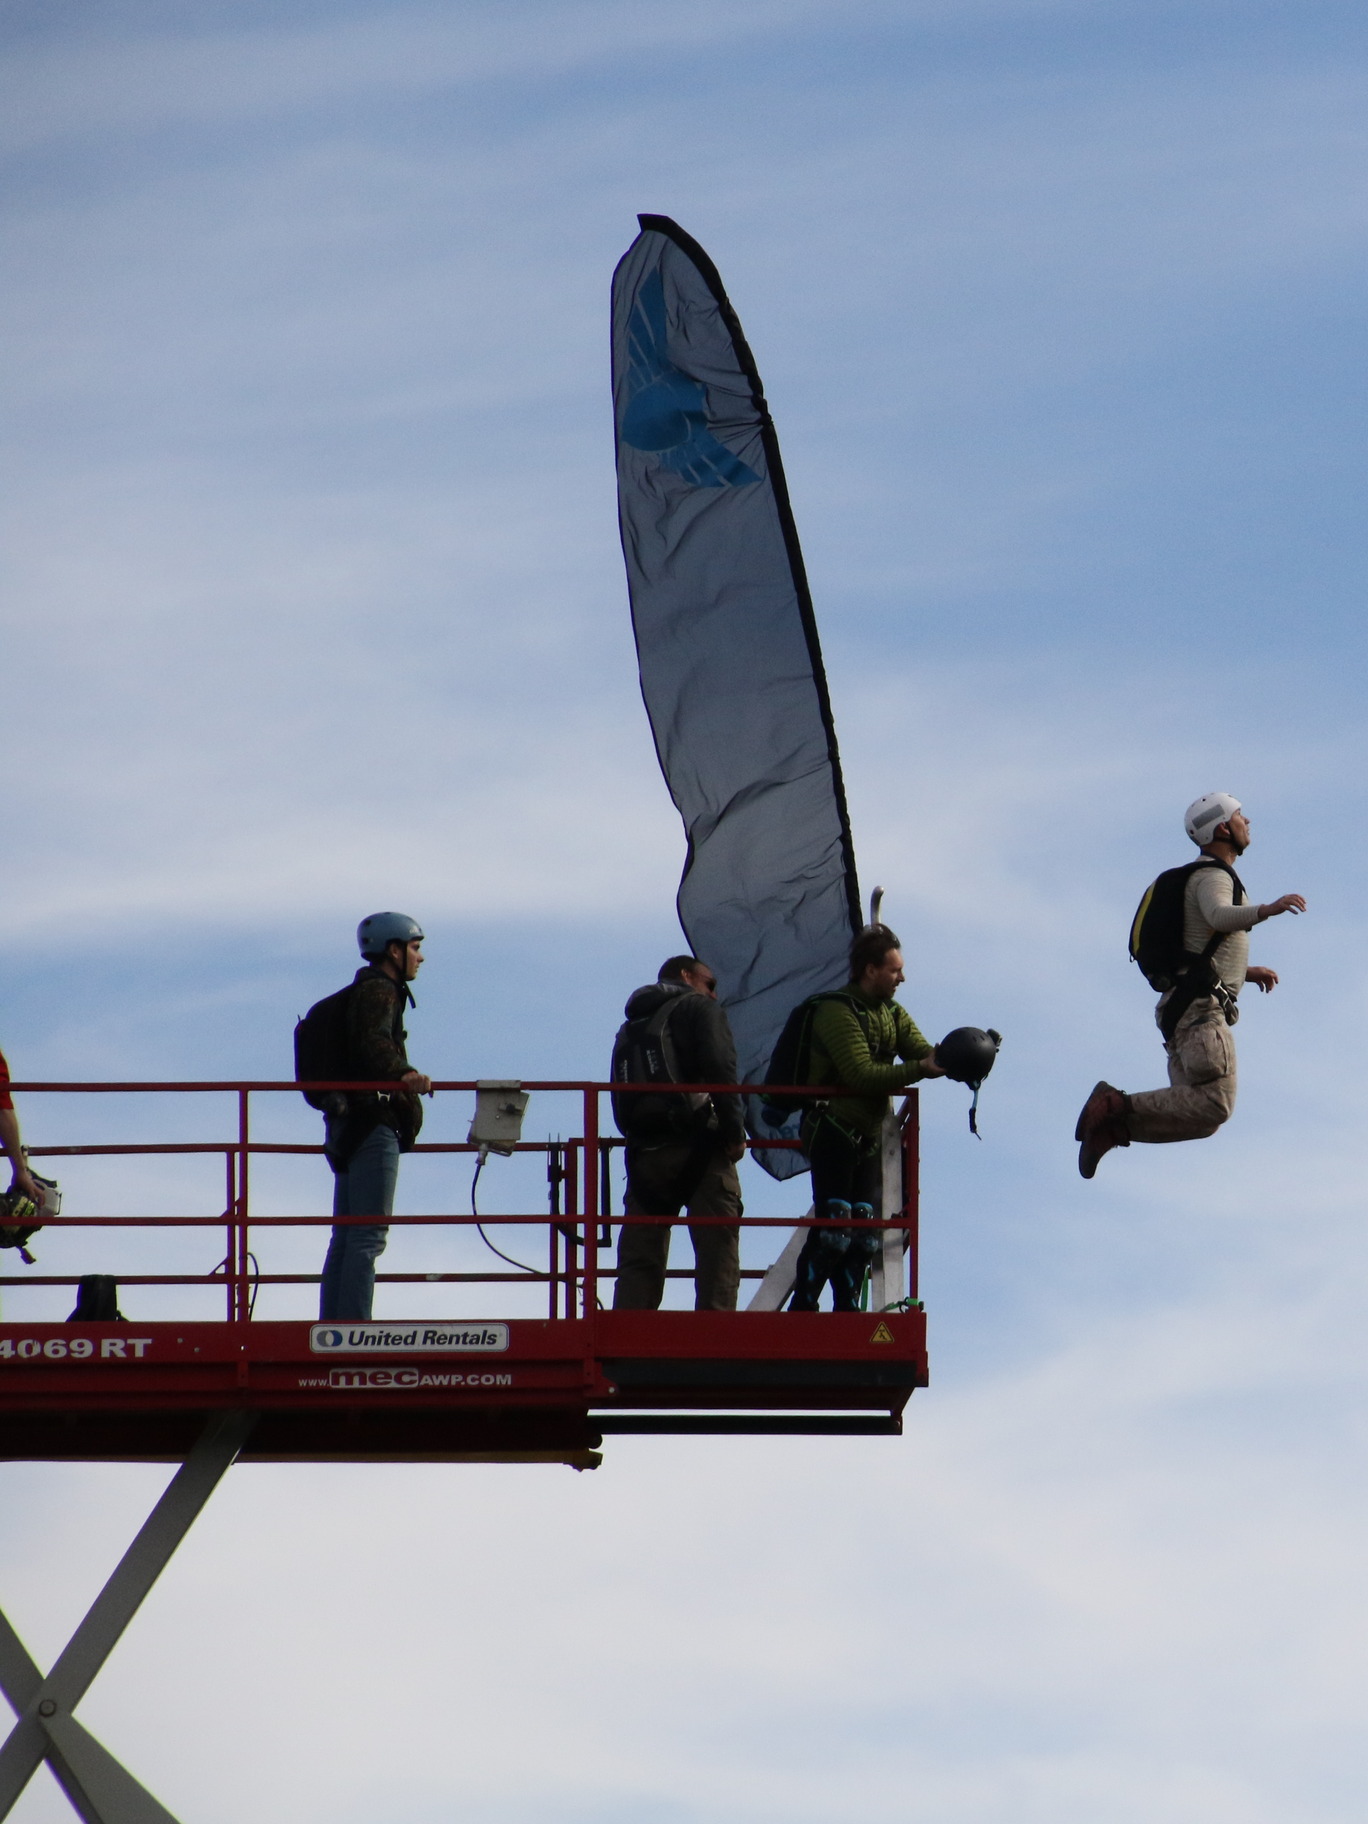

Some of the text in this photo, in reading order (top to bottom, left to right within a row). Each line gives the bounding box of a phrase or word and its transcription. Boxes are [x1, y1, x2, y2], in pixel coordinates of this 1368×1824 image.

[348, 1329, 497, 1346] United Rentals
[0, 1339, 152, 1358] 4069 RT
